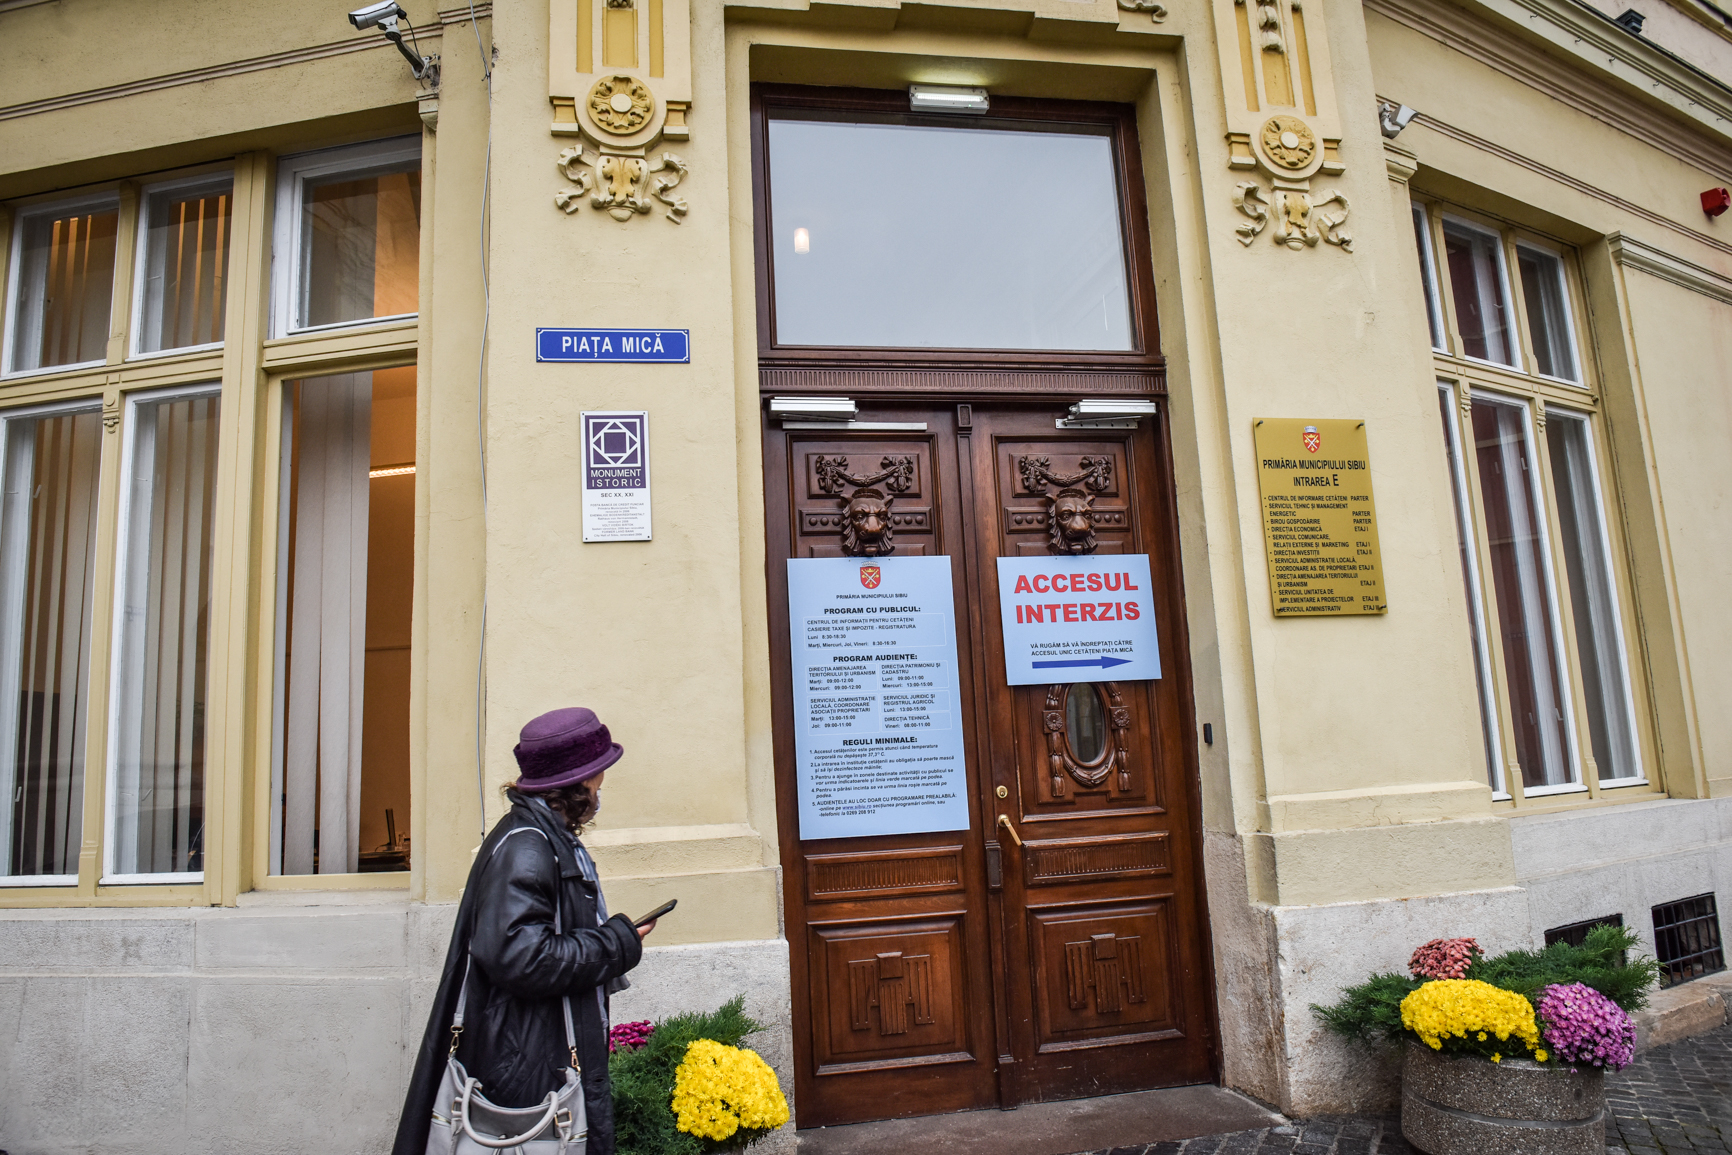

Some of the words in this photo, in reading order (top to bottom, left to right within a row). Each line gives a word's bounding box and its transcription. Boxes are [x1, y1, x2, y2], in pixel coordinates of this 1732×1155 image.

[562, 336, 613, 358] PIAȚA
[622, 333, 664, 353] MICĂ
[1263, 457, 1298, 469] PRIMĂRIA
[1298, 460, 1346, 470] MUNICIPIULUI
[1347, 460, 1366, 470] SIBIU
[591, 469, 641, 478] MONUMENT
[592, 478, 641, 487] ISTORIC
[1293, 476, 1331, 487] INTRAREA
[1332, 474, 1339, 486] E
[1014, 572, 1139, 594] ACCESUL
[1016, 601, 1140, 624] INTERZIS
